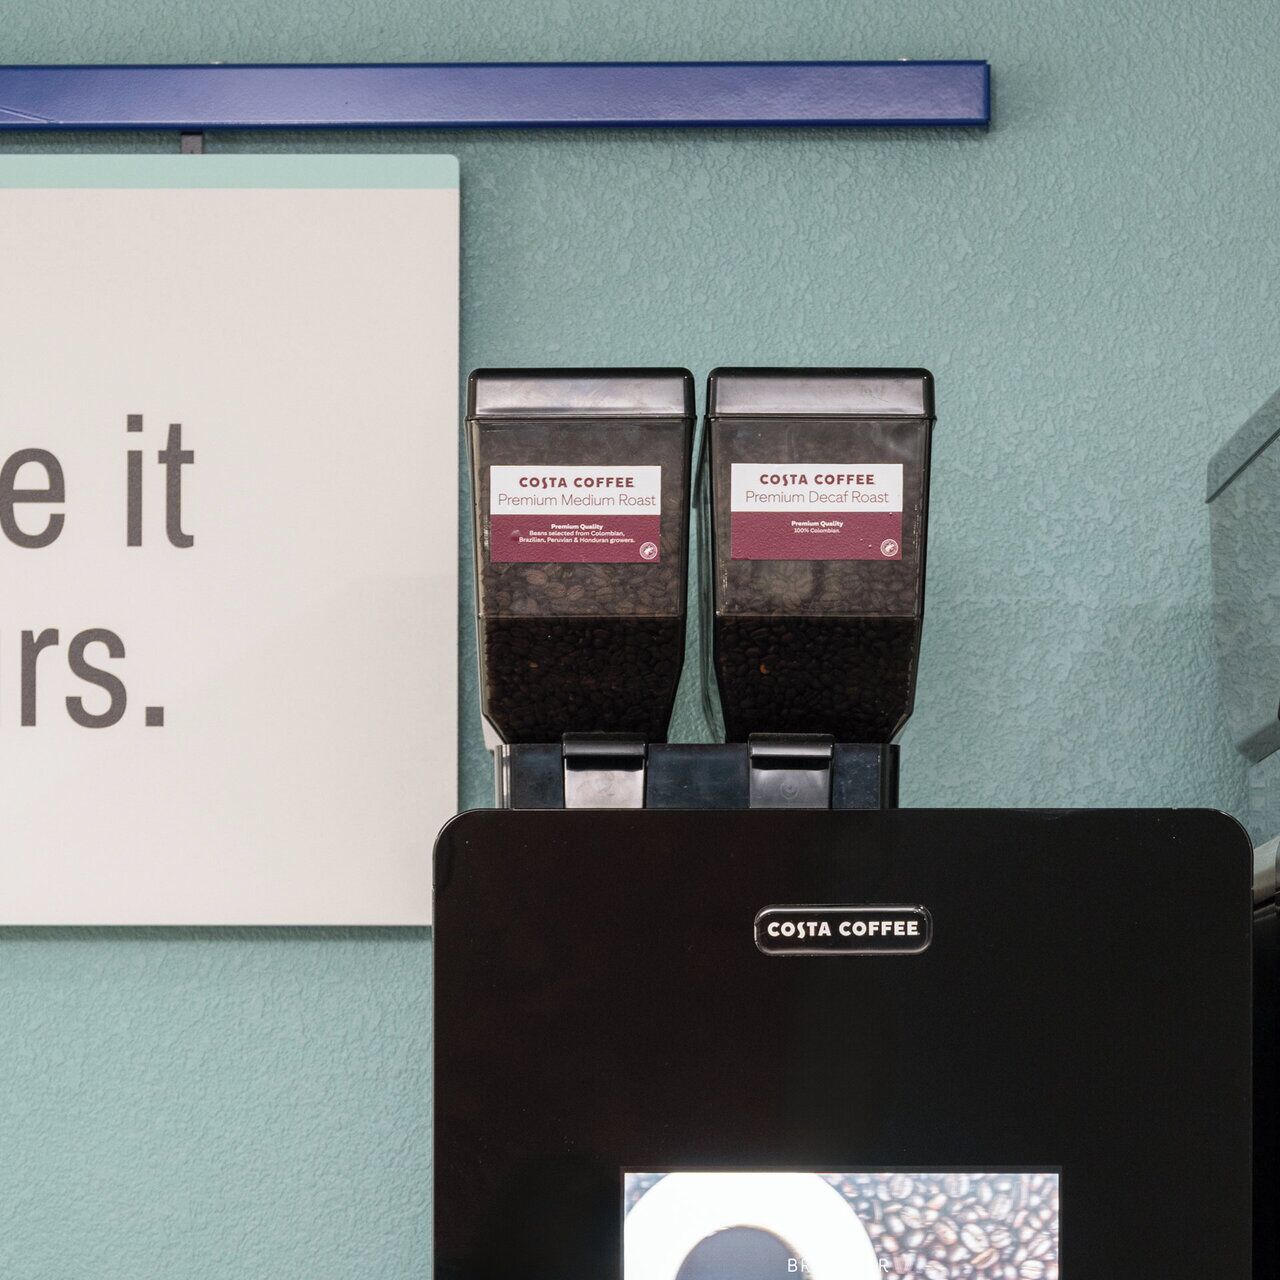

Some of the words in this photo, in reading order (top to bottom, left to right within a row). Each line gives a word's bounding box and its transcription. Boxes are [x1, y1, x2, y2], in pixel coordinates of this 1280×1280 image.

[126, 414, 195, 548] it
[519, 477, 567, 489] COSTA
[573, 477, 635, 488] COFFEE
[760, 474, 808, 486] COSTA
[814, 474, 875, 485] COFFEE
[498, 493, 558, 506] Premium
[561, 493, 615, 506] Medium
[619, 493, 656, 506] Roast
[746, 491, 805, 503] Premium
[809, 491, 849, 503] Decaf
[851, 491, 889, 503] Roast
[580, 523, 604, 531] Quality
[767, 921, 832, 939] COSTA
[838, 921, 920, 936] COFFEE
